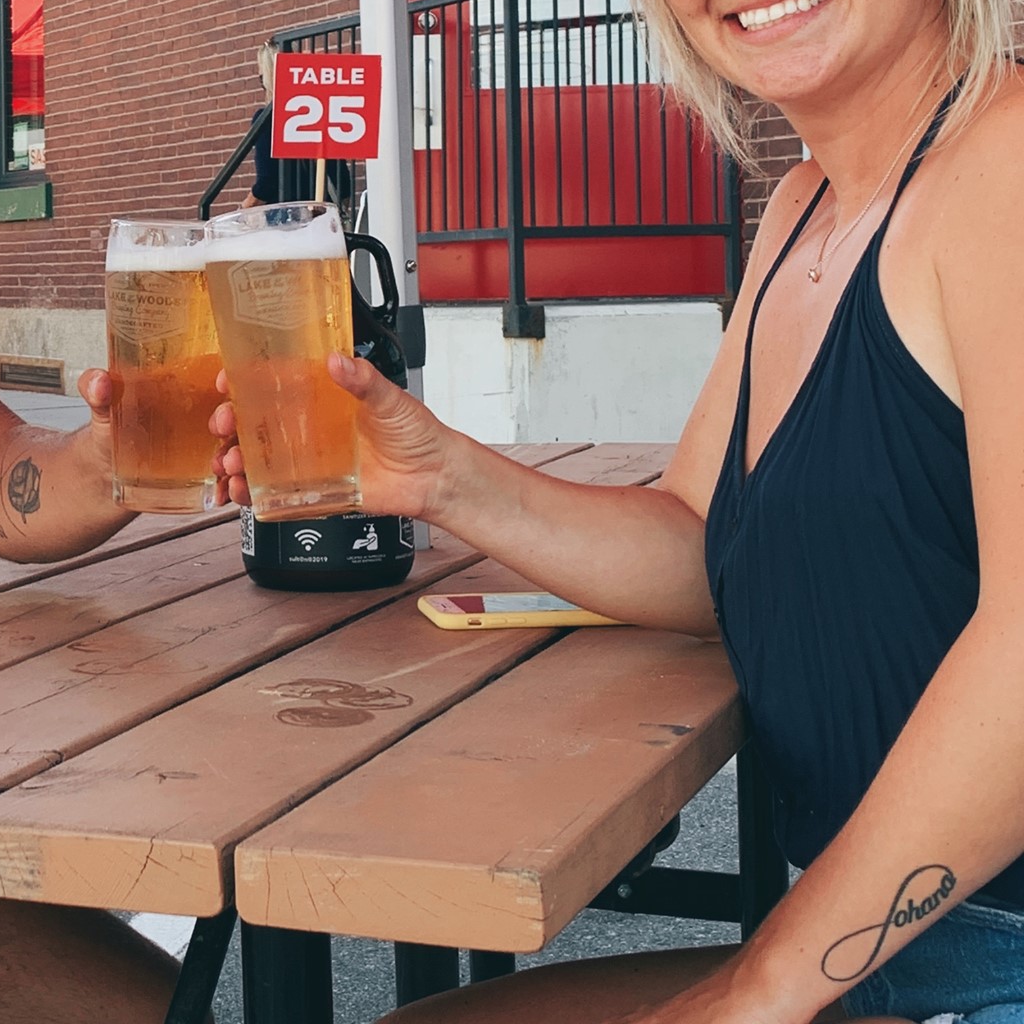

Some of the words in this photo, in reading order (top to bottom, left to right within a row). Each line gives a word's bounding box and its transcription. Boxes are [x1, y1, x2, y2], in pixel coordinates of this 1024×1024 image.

[289, 67, 365, 85] TABLE
[282, 95, 367, 144] 25
[893, 874, 957, 928] ohana
